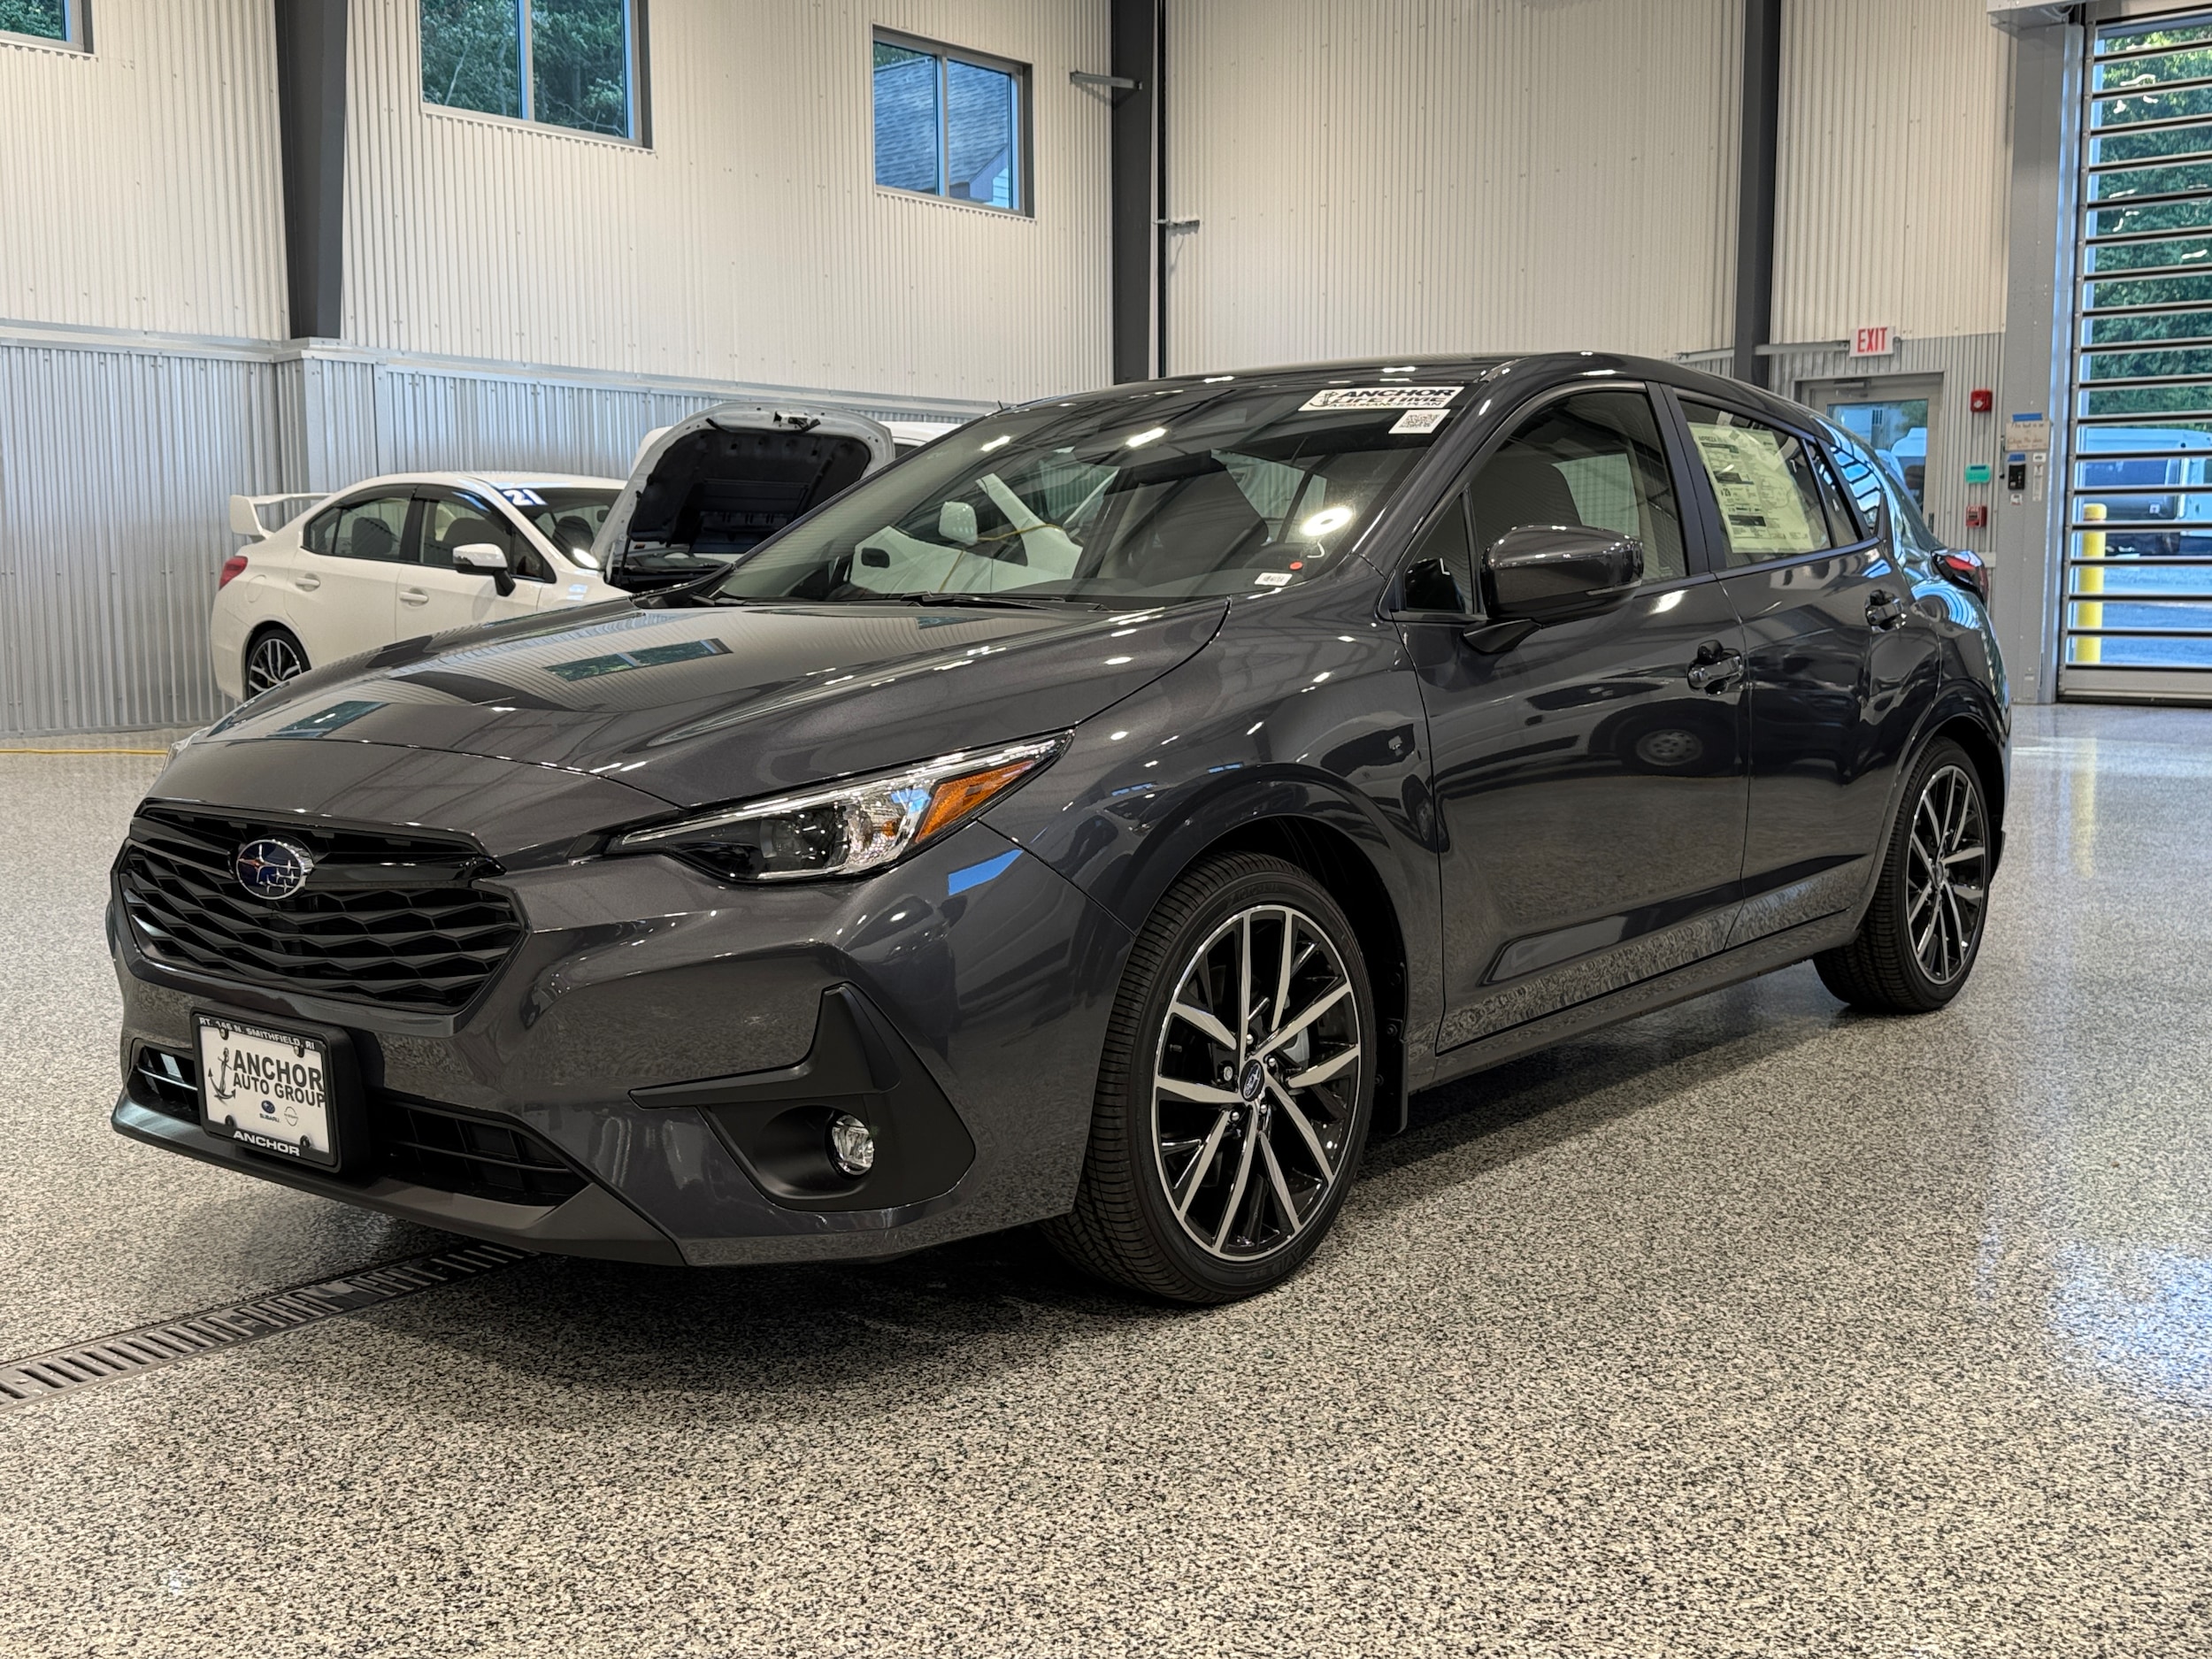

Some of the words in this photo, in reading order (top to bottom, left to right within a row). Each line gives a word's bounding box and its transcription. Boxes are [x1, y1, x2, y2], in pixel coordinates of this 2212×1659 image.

[1857, 326, 1888, 353] EXIT
[1339, 388, 1456, 397] ANCHOR
[503, 488, 549, 505] 21
[199, 1017, 213, 1026] RT.
[233, 1024, 245, 1033] N.
[245, 1027, 303, 1048] SMITHFIELD,
[305, 1040, 315, 1050] RI
[233, 1049, 325, 1093] ANCHOR
[233, 1072, 270, 1095] AUTO
[273, 1082, 326, 1108] GROUP
[233, 1130, 301, 1156] ANCHOR
